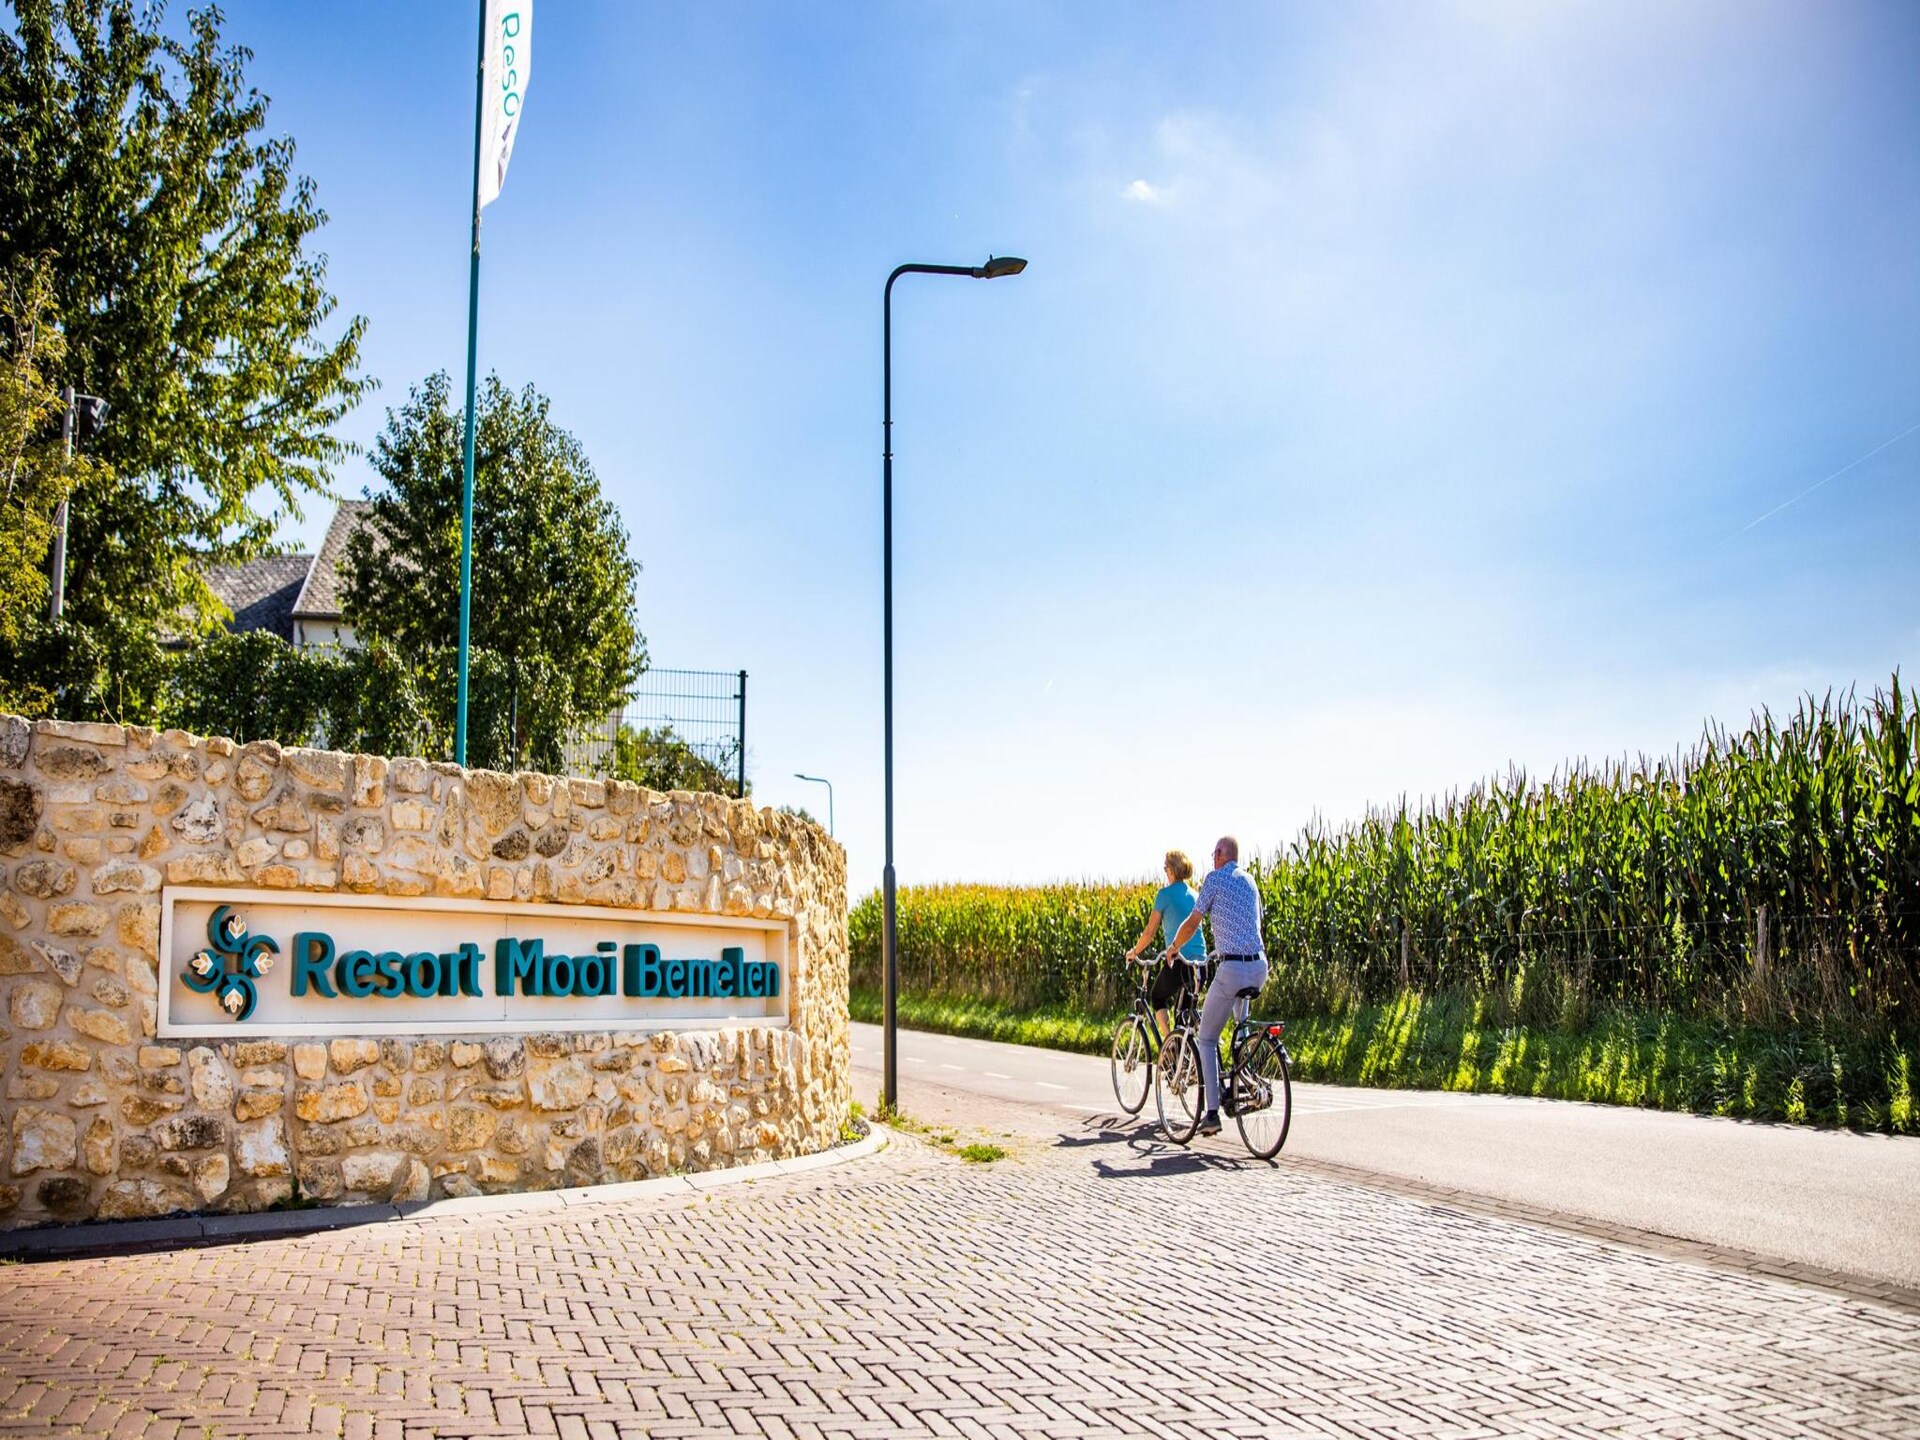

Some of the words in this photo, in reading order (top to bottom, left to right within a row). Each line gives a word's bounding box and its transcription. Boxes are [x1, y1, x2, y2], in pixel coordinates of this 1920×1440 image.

[290, 931, 485, 998] Resort
[495, 937, 617, 997] Mooi
[624, 943, 780, 998] Bemelen
